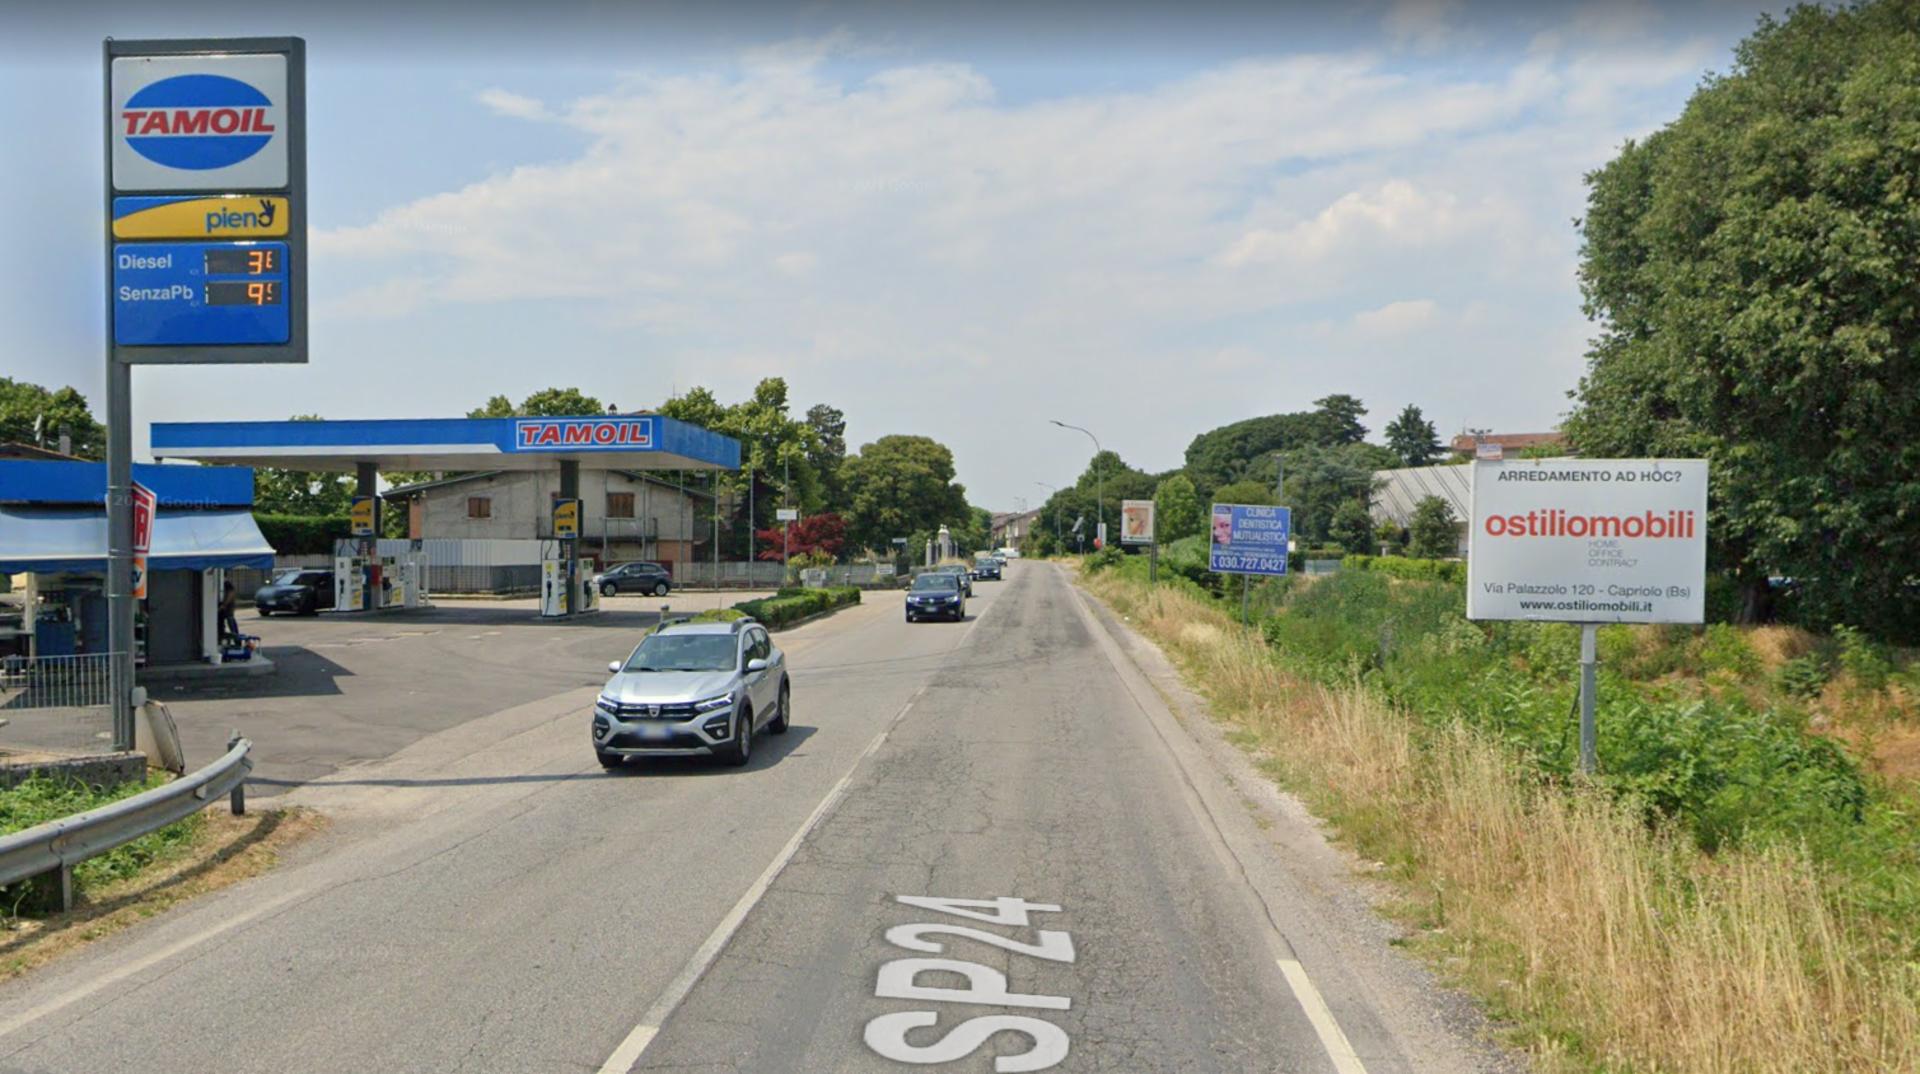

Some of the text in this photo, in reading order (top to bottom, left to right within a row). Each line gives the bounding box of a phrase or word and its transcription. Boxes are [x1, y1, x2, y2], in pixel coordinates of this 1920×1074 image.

[122, 107, 275, 134] TAMOIL
[119, 254, 172, 269] Diesel
[120, 285, 193, 301] SenzaPb
[521, 423, 649, 445] TAMOIL
[1498, 470, 1682, 482] ARREDAMENTO AD HOC?
[1239, 519, 1282, 530] DENTISTICA
[1485, 509, 1694, 538] ostiliomobili
[1588, 549, 1623, 557] OFFICE
[1219, 556, 1285, 571] 030.727.0427
[1588, 558, 1638, 567] CONTRACT
[1484, 583, 1504, 594] Via
[1507, 583, 1568, 595] Palazzolo
[1571, 584, 1595, 595] 120
[1607, 585, 1663, 598] Capriolo
[1665, 586, 1691, 599] (Bs)
[1520, 599, 1653, 613] www.ostiliomobili.it
[864, 896, 1076, 1073] SP24
